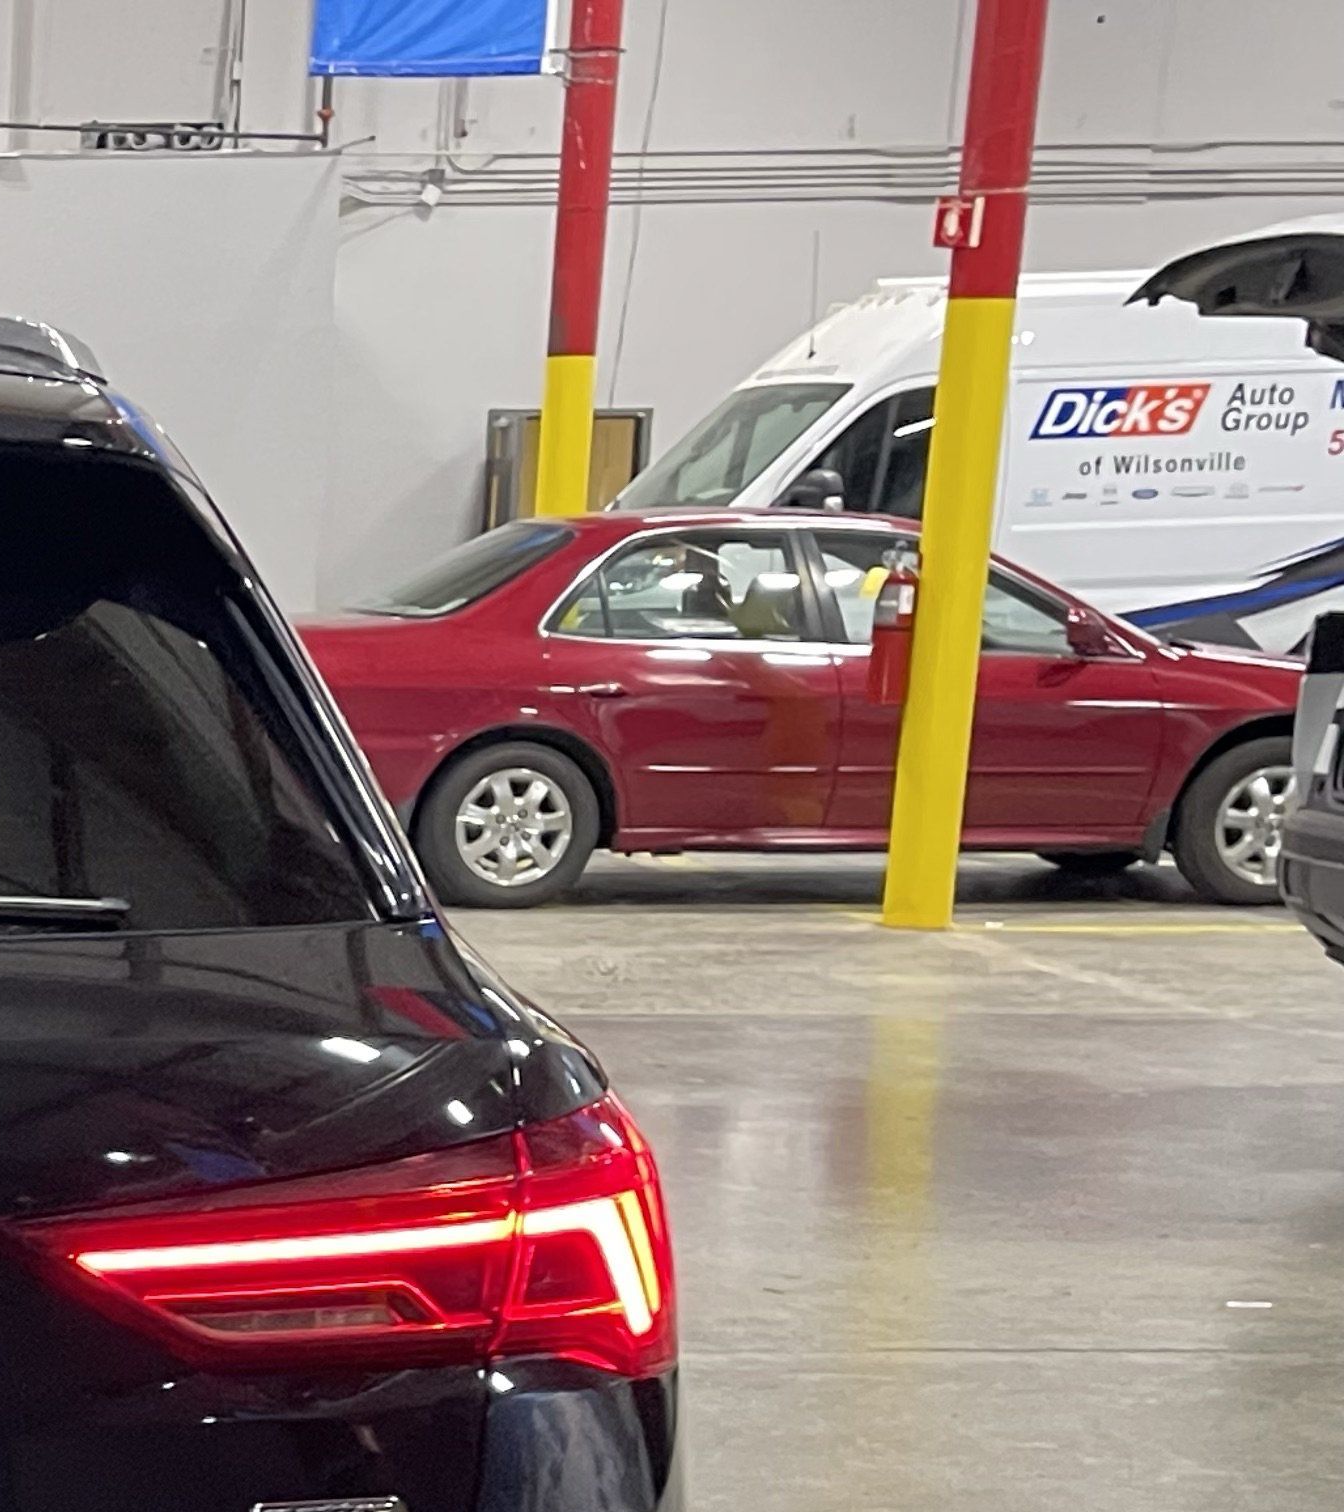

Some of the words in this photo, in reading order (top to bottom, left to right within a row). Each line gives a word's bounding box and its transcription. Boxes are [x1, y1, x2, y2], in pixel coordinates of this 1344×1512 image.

[1226, 383, 1294, 406] Auto
[1038, 388, 1193, 436] Dick's
[1221, 407, 1309, 436] Group
[1079, 455, 1103, 476] of
[1113, 452, 1246, 475] Wilsonville
